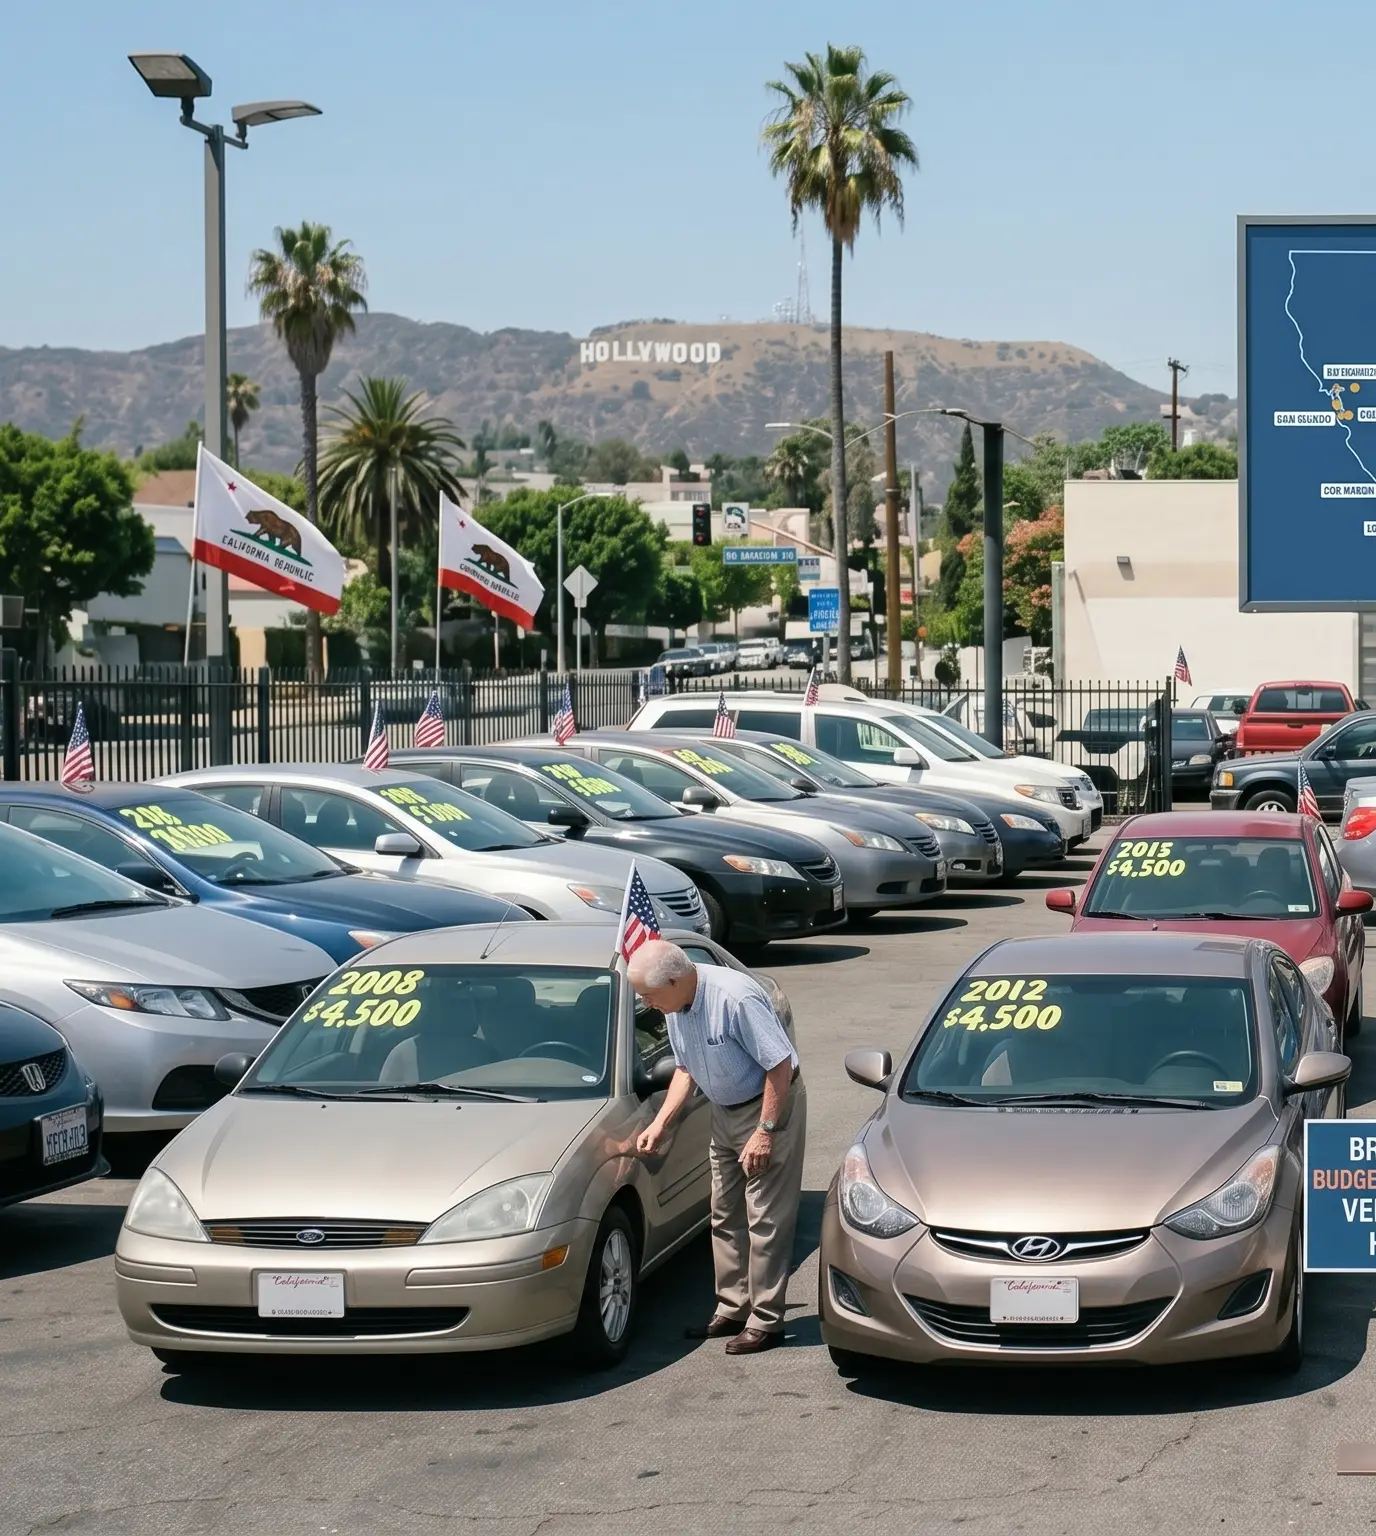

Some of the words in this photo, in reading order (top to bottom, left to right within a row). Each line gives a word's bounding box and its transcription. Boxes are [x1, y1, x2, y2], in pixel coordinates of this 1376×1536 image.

[580, 340, 721, 364] HOLLYWOOD
[1116, 841, 1174, 859] 2015
[328, 969, 425, 995] 2008
[960, 979, 1048, 1002] 2012
